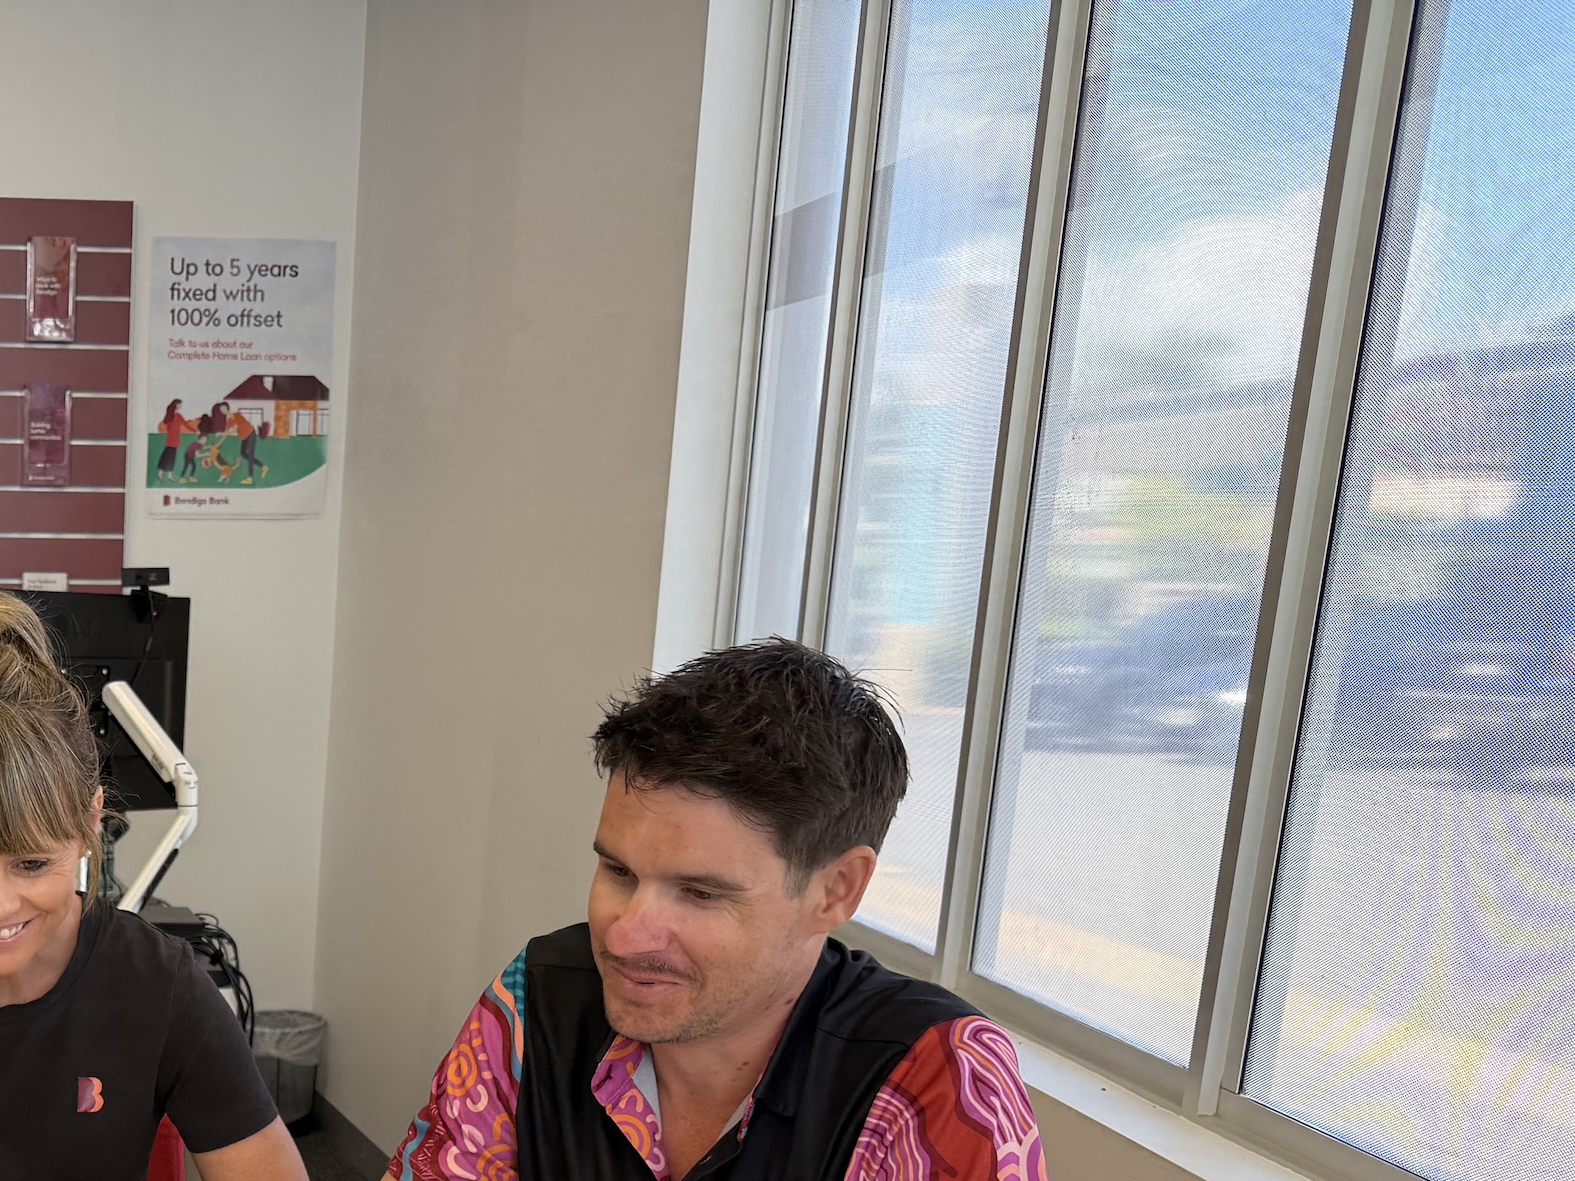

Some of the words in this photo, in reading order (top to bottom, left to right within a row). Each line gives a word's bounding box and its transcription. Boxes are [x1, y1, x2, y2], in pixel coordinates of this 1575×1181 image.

[170, 257, 198, 282] Up
[204, 259, 224, 277] to
[229, 258, 241, 277] 5
[247, 263, 299, 283] years
[170, 282, 217, 301] fixed
[223, 283, 265, 302] with
[170, 308, 221, 327] 100%
[227, 309, 283, 328] offset
[168, 338, 185, 348] Talk
[188, 339, 198, 348] to
[199, 341, 210, 349] us
[211, 339, 237, 349] about
[239, 341, 254, 349] our
[167, 350, 211, 361] Complete
[213, 351, 239, 360] Home
[240, 351, 262, 361] Loan
[264, 352, 298, 362] options
[175, 496, 207, 507] Bendigo
[209, 496, 230, 505] Bank
